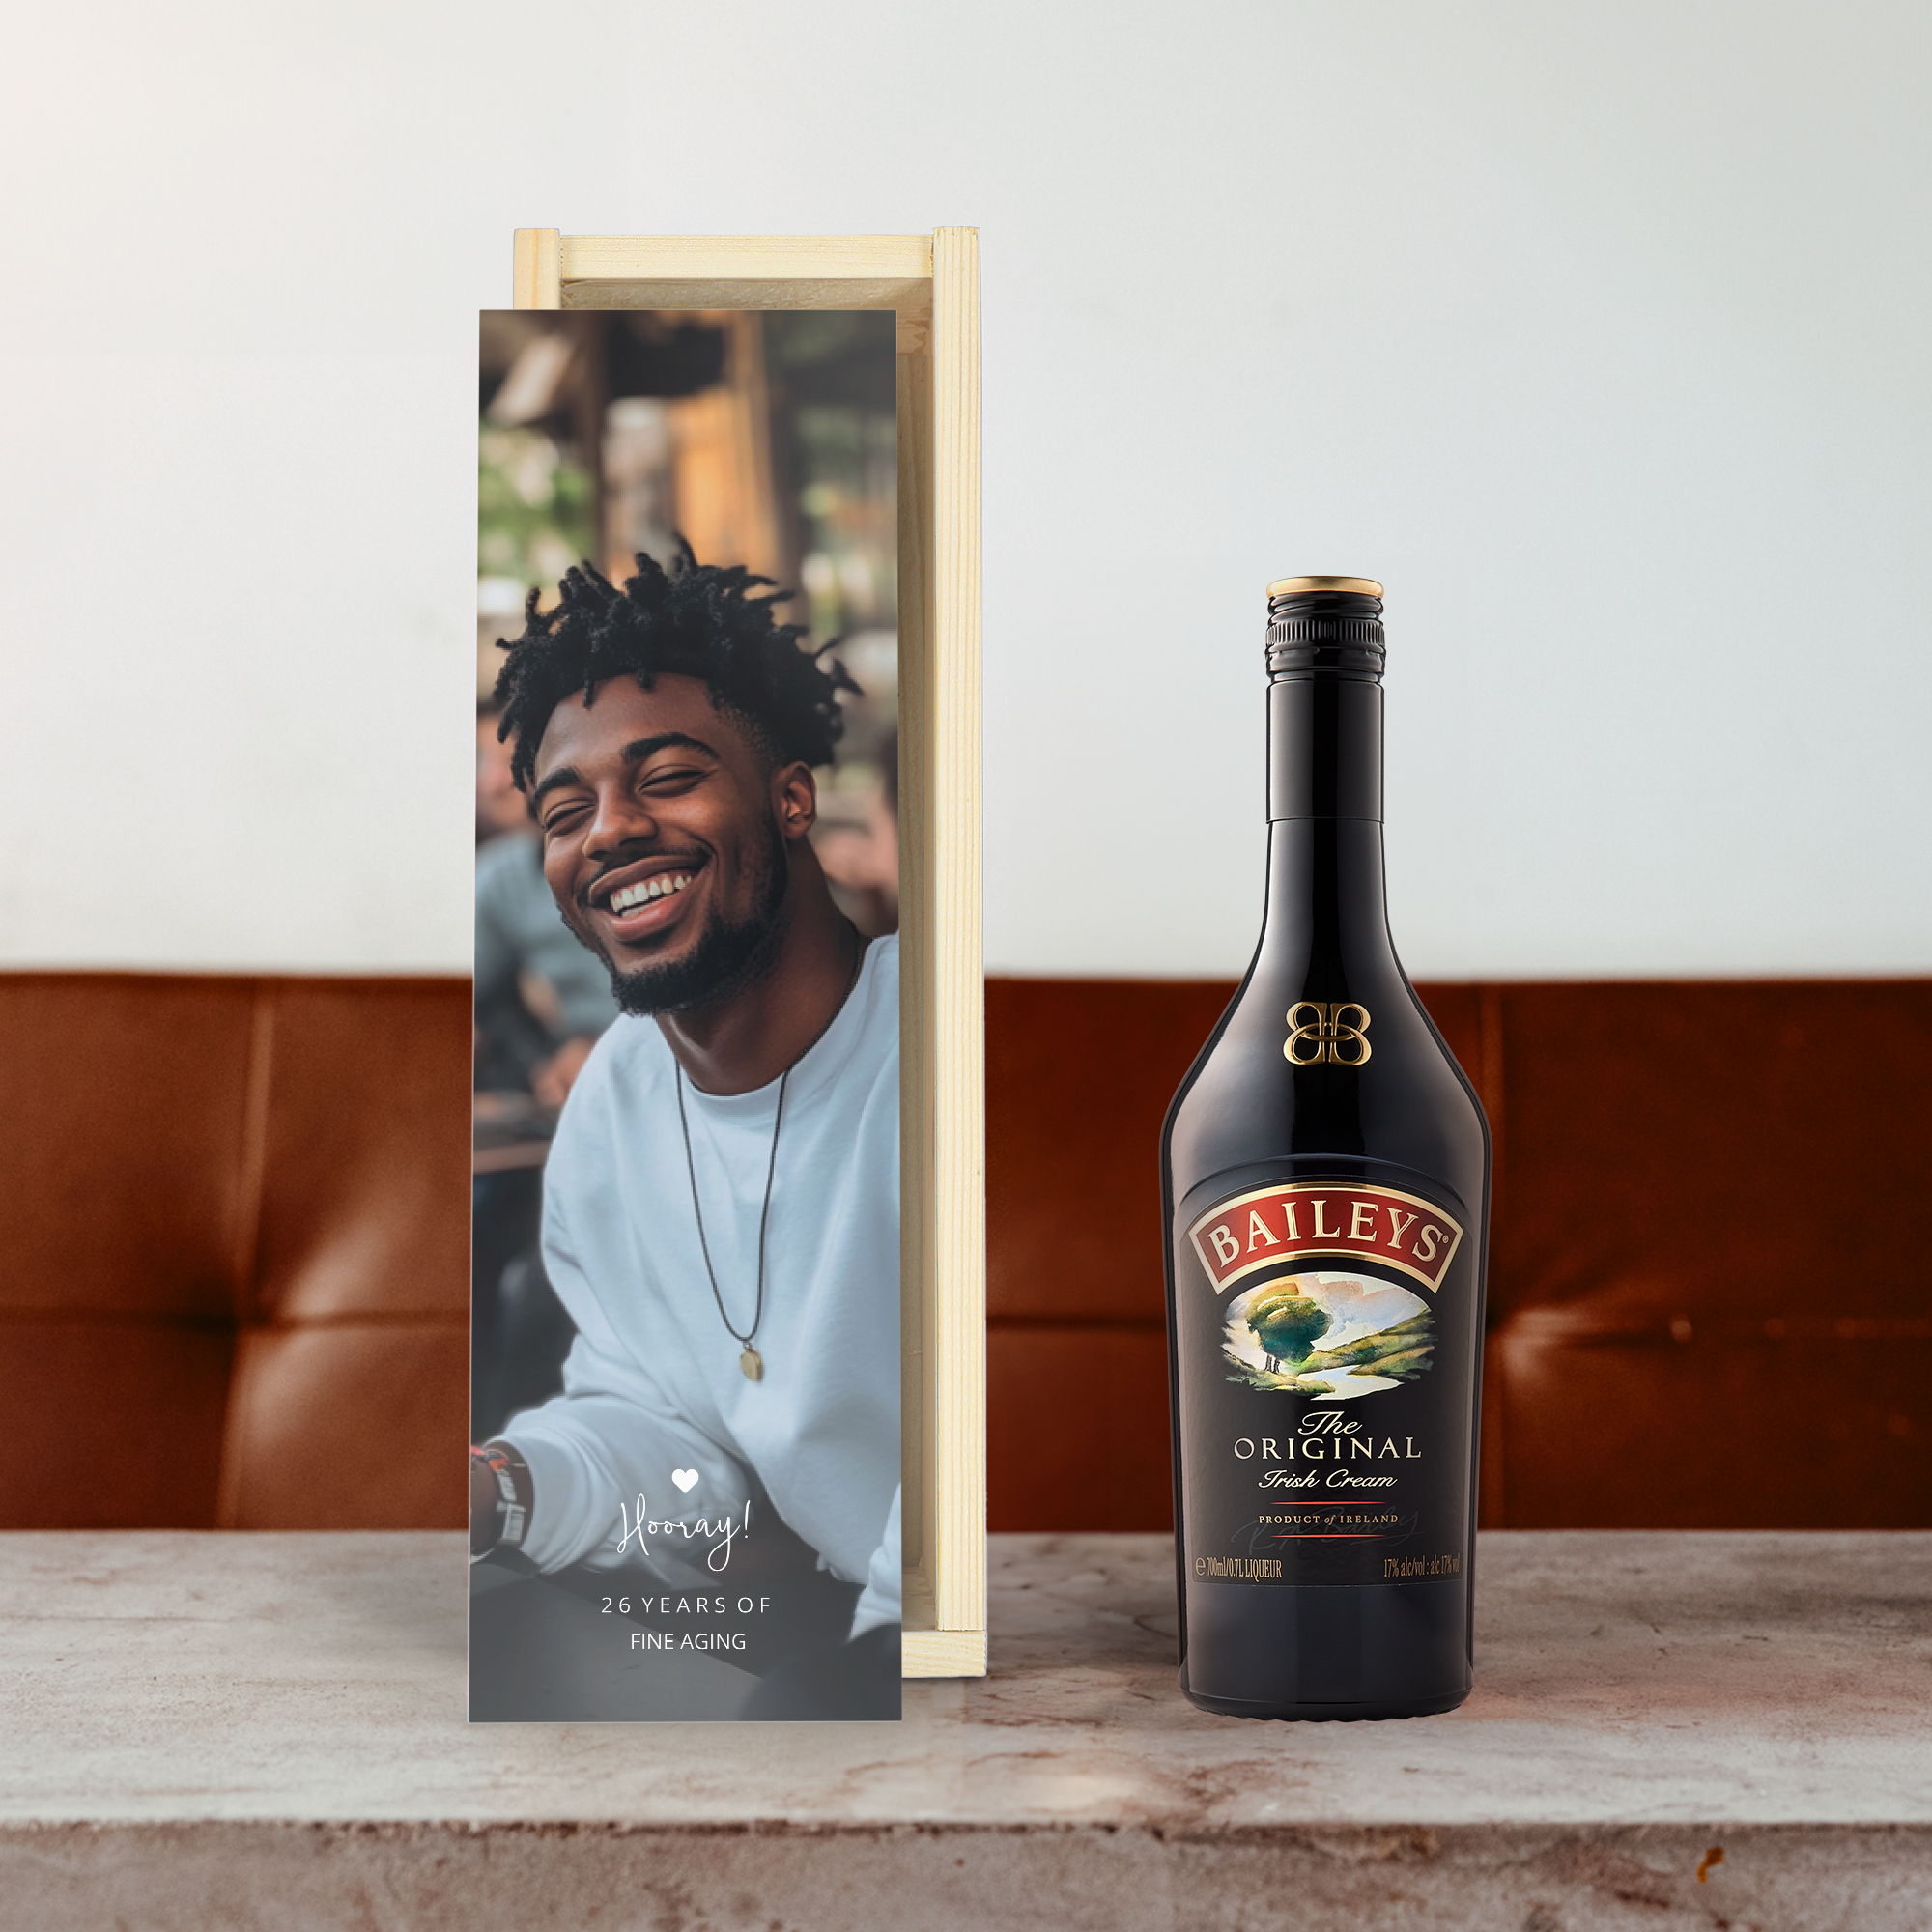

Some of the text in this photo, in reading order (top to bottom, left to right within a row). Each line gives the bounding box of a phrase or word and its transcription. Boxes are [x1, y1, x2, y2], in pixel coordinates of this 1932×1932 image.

[1297, 1411, 1363, 1435] The
[1234, 1436, 1422, 1460] ORIGINAL
[1258, 1468, 1398, 1489] Irish Cream
[1259, 1514, 1399, 1525] PRODUCT of IRELAND
[617, 1493, 751, 1572] Hooray!
[1207, 1556, 1243, 1577] 700ml/0.7L
[1245, 1558, 1282, 1582] LIQUEUR
[1384, 1558, 1399, 1577] 17%
[1401, 1556, 1425, 1576] alc/vol
[1430, 1554, 1439, 1574] alc
[601, 1597, 770, 1613] 26 YEARS OF
[631, 1633, 746, 1650] FINE AGING
